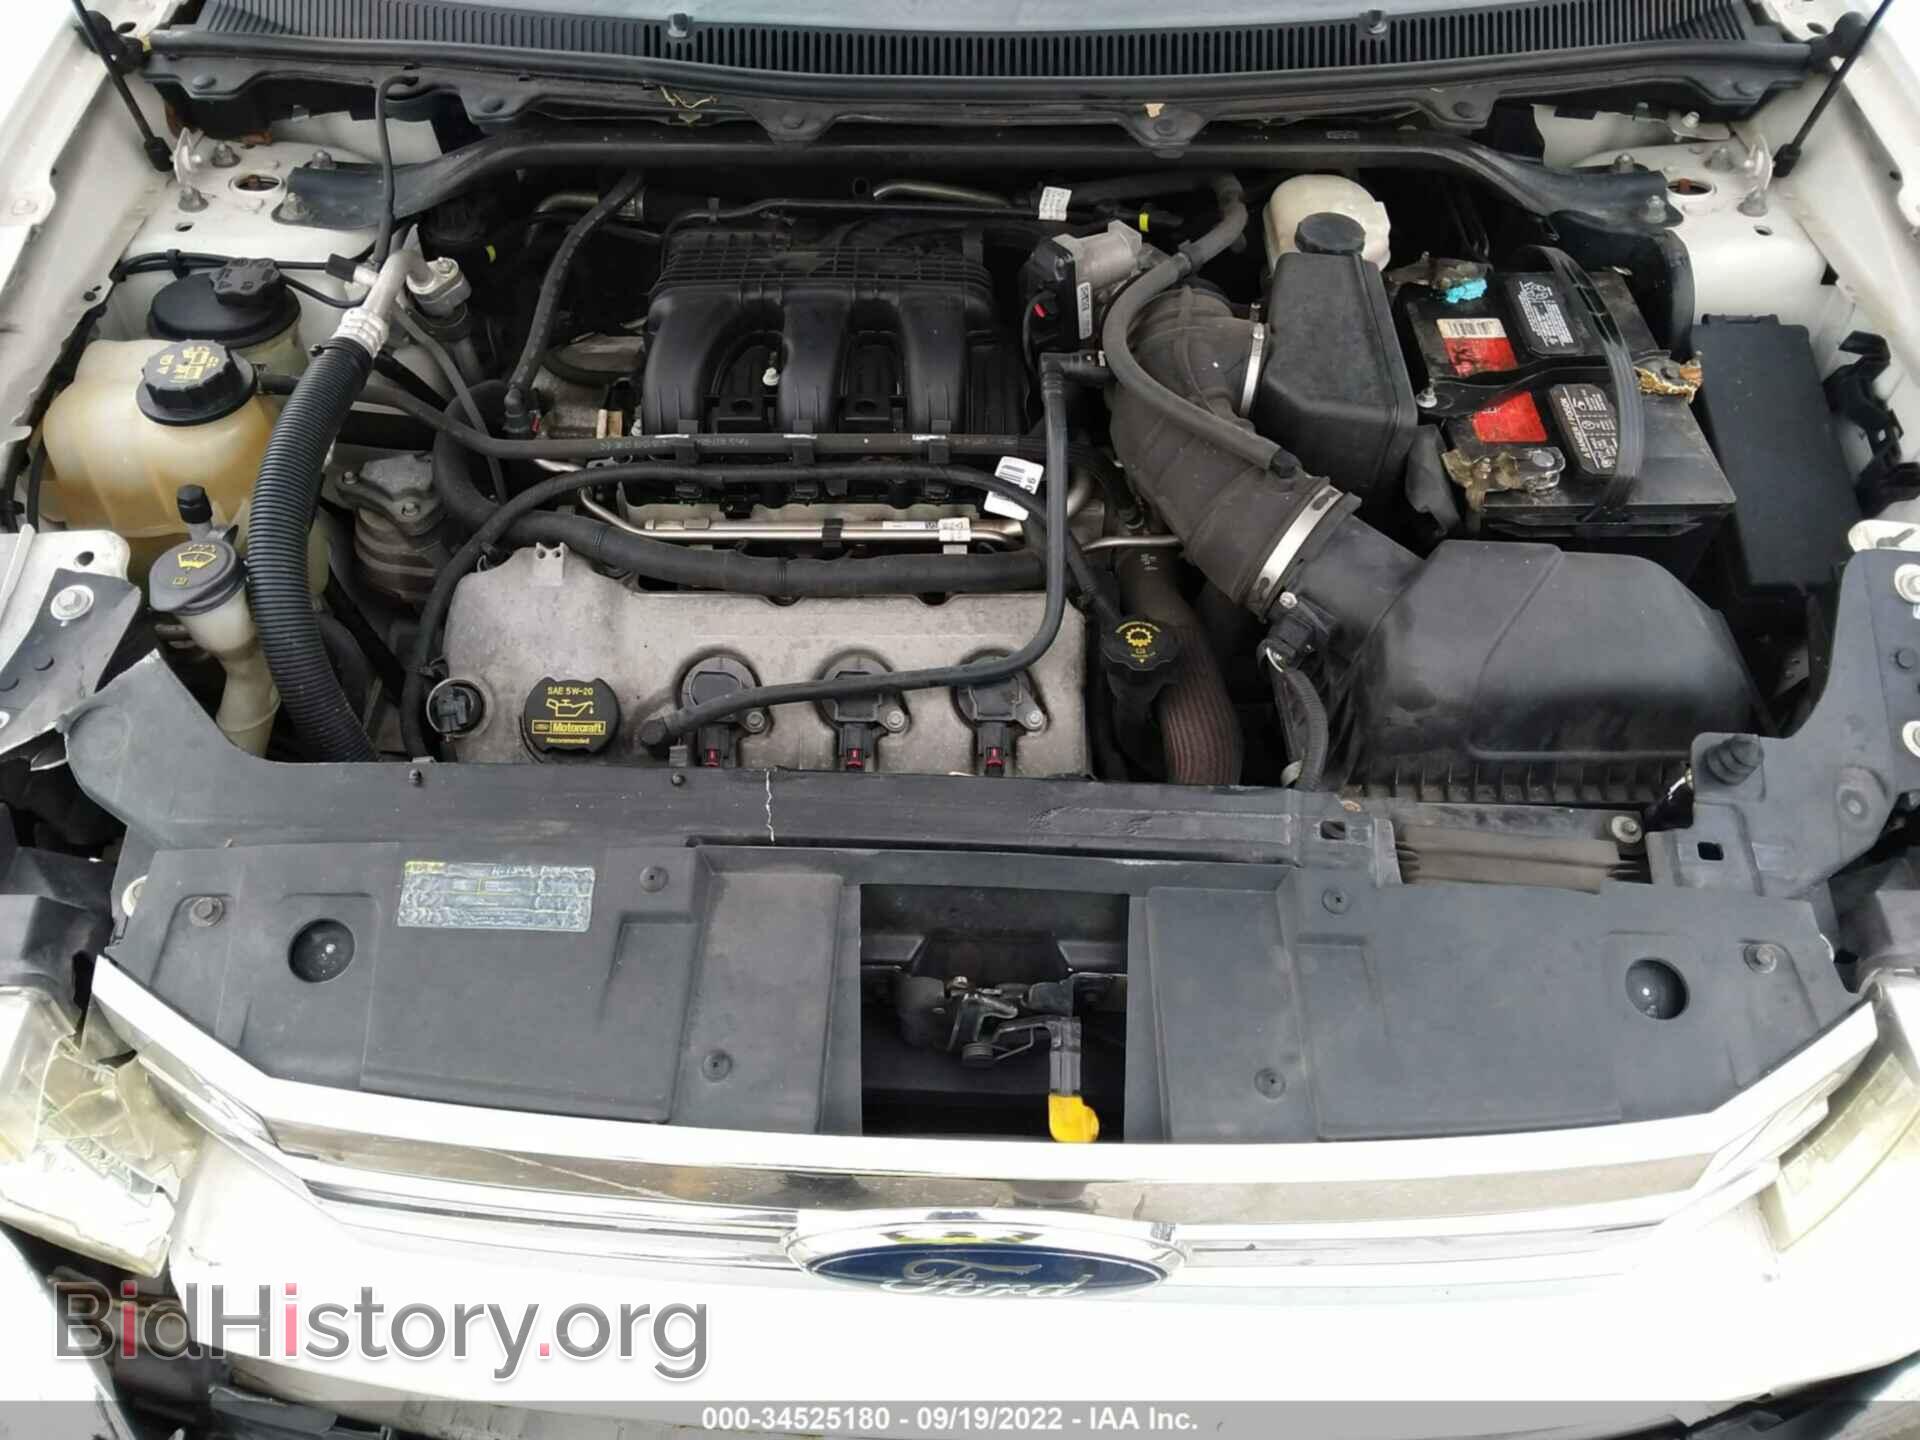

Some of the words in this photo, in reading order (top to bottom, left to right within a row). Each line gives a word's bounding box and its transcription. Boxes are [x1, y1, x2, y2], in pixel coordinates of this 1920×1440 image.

[547, 686, 563, 695] SAE
[566, 686, 593, 695] 5W-20
[553, 722, 602, 733] Motorcraft
[880, 1258, 1093, 1296] Ford
